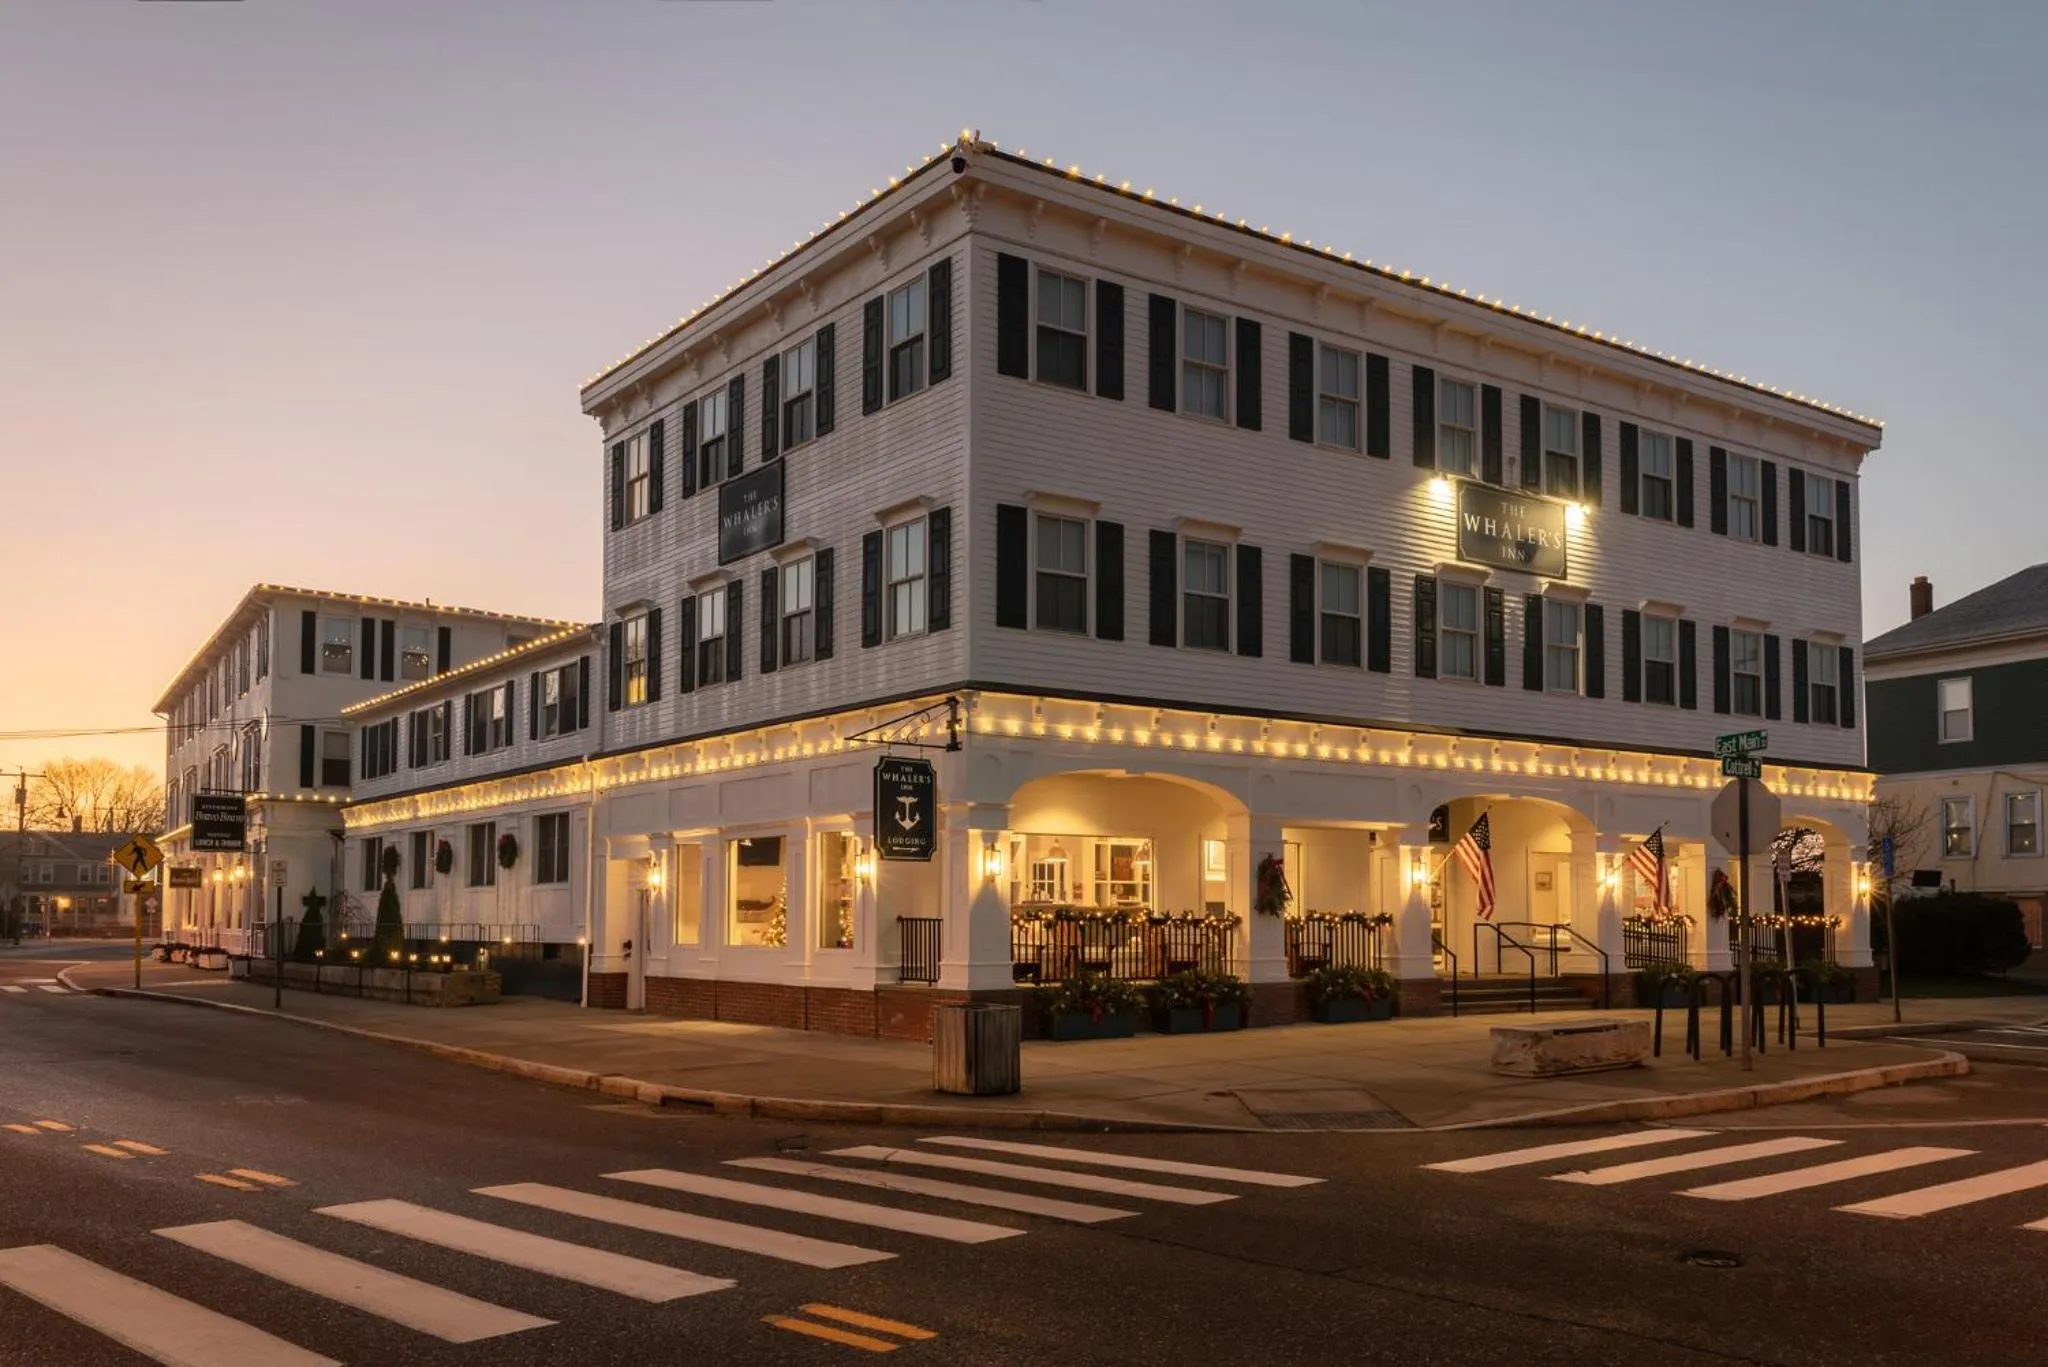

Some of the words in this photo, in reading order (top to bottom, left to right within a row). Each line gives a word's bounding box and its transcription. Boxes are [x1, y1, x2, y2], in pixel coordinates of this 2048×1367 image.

[743, 490, 757, 503] THE
[723, 495, 778, 529] WHALER'S
[1500, 502, 1527, 518] THE
[1464, 512, 1562, 549] WHALER'S
[1502, 545, 1526, 561] INN
[1716, 736, 1736, 753] East
[1739, 733, 1759, 751] Main
[882, 772, 931, 784] WHALER'S
[887, 836, 927, 845] LODGING
